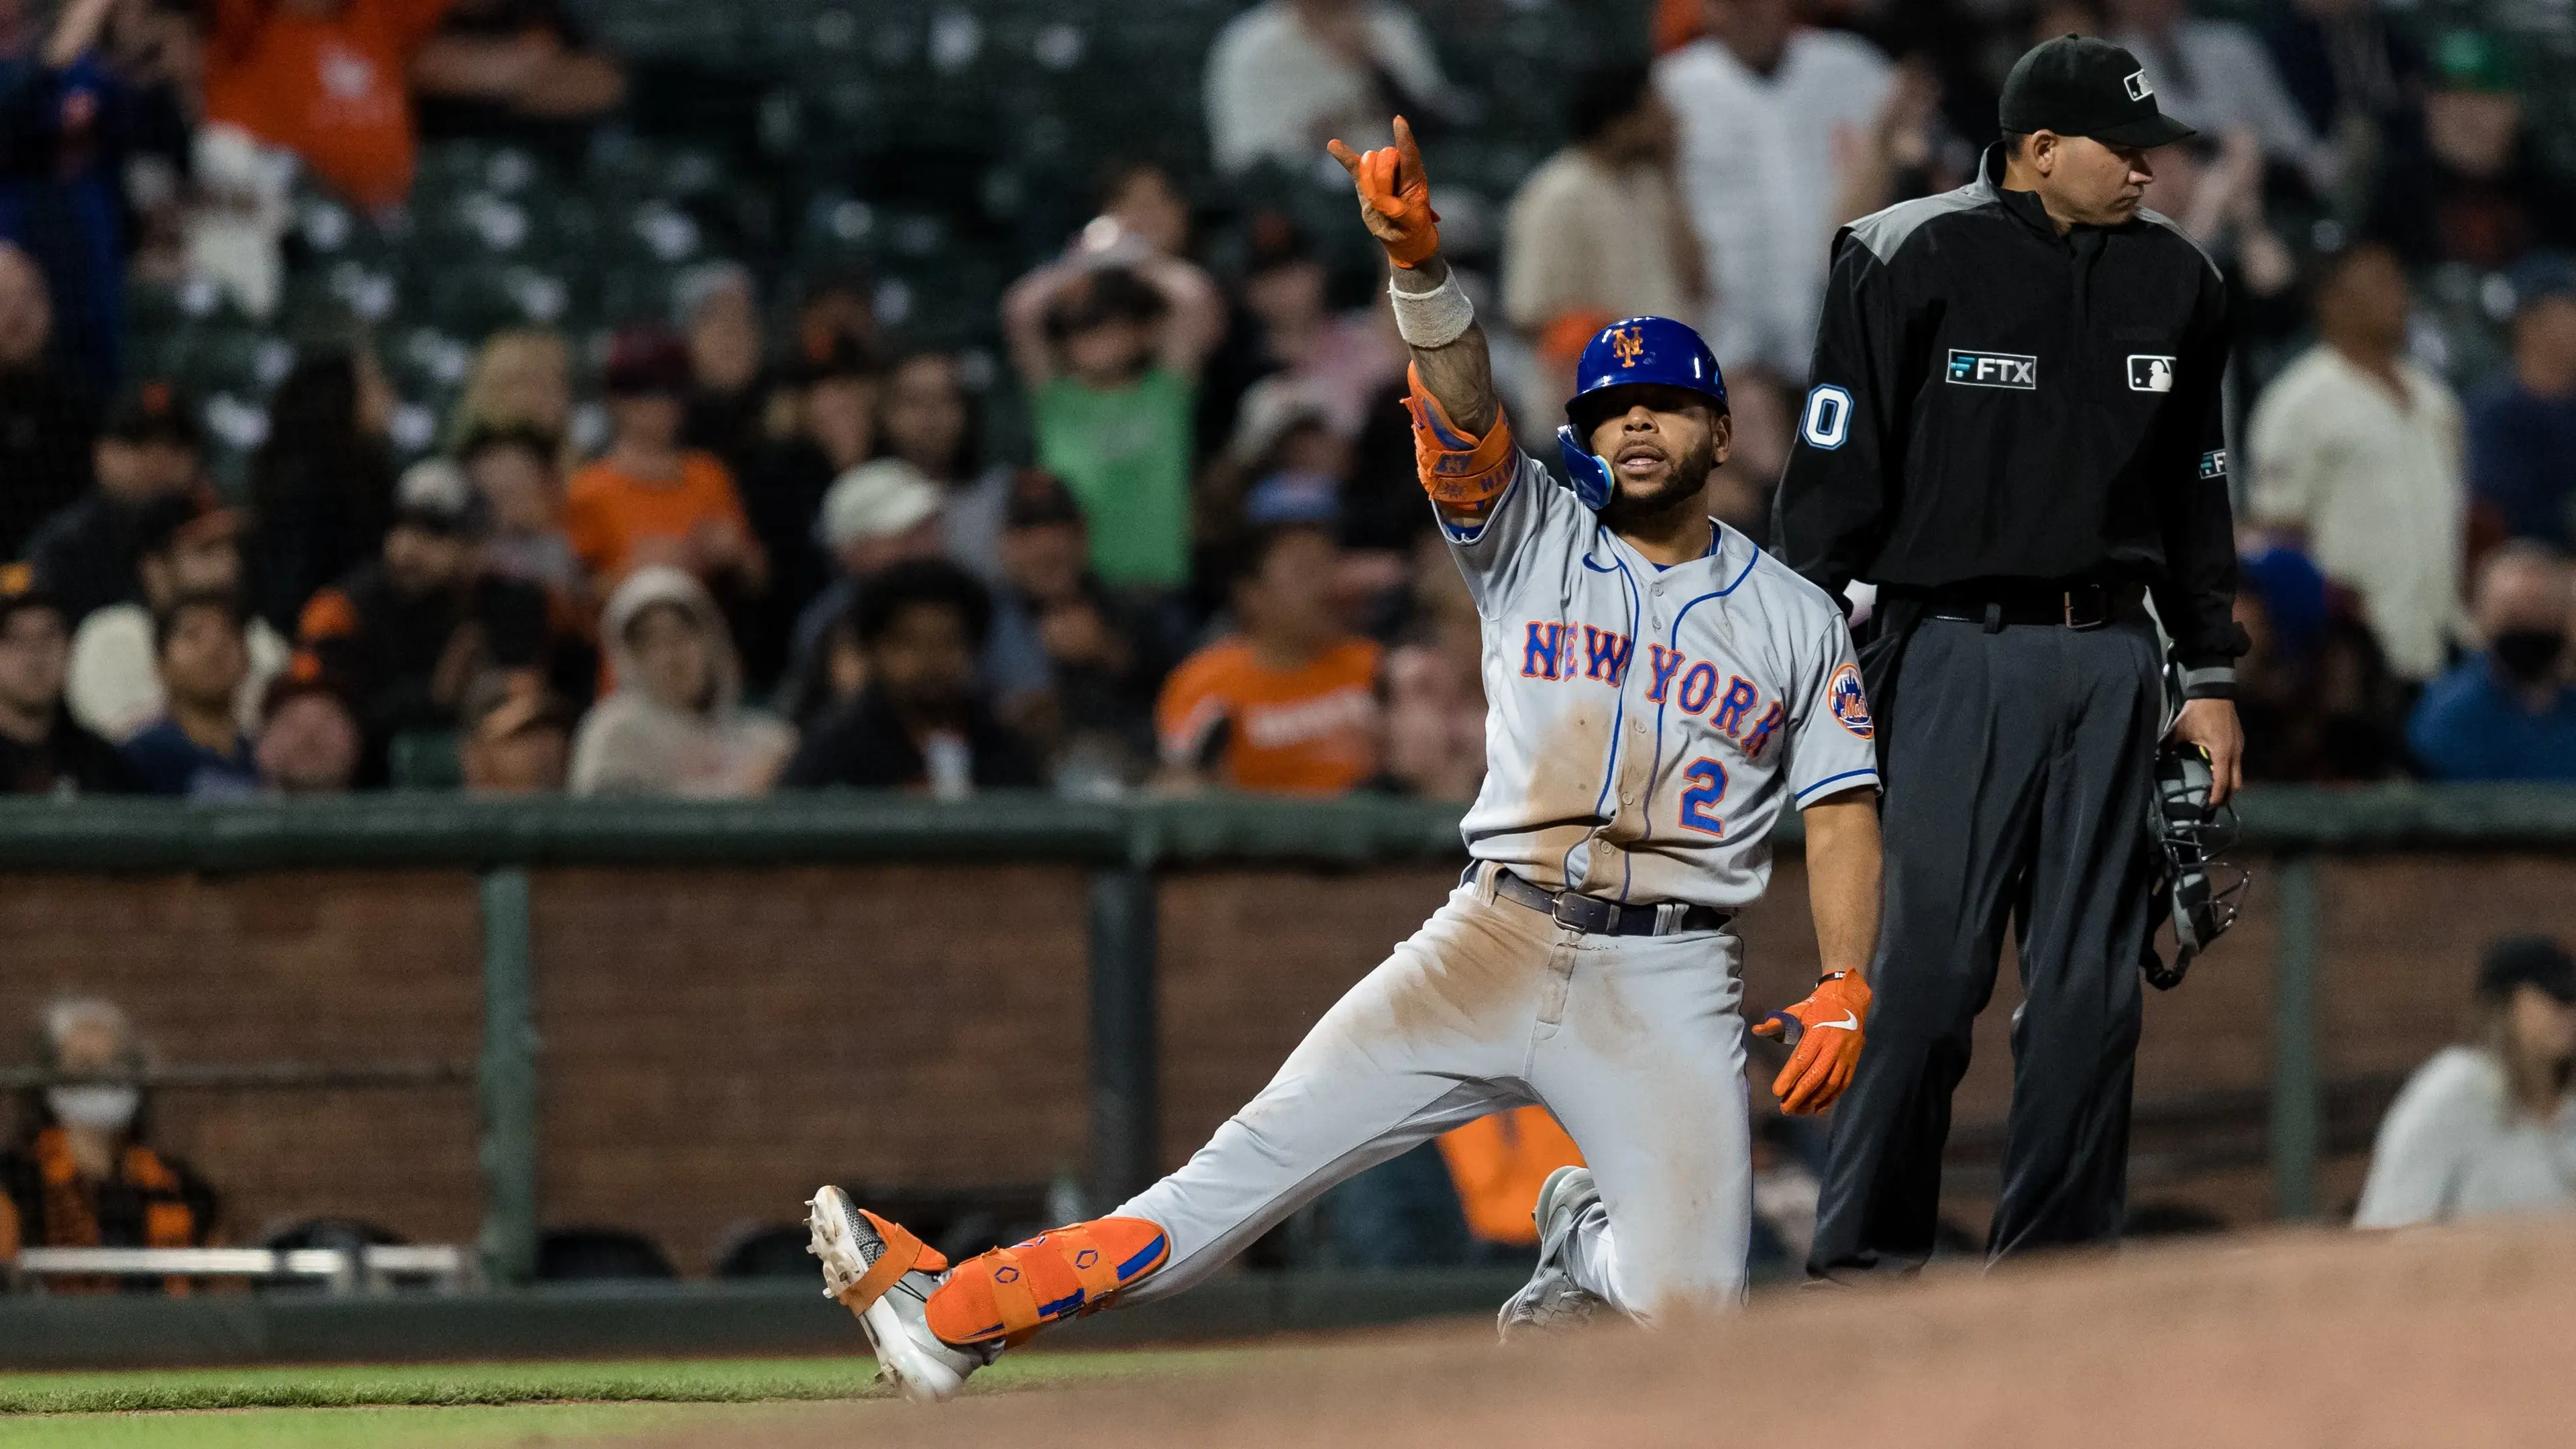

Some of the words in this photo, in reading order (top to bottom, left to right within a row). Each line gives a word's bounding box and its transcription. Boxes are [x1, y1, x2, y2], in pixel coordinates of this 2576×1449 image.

[1976, 358, 2033, 384] FTX
[1802, 383, 1854, 450] 0
[1519, 621, 1632, 688] NEW
[1645, 643, 1785, 757] YORK
[1678, 756, 1729, 838] 2
